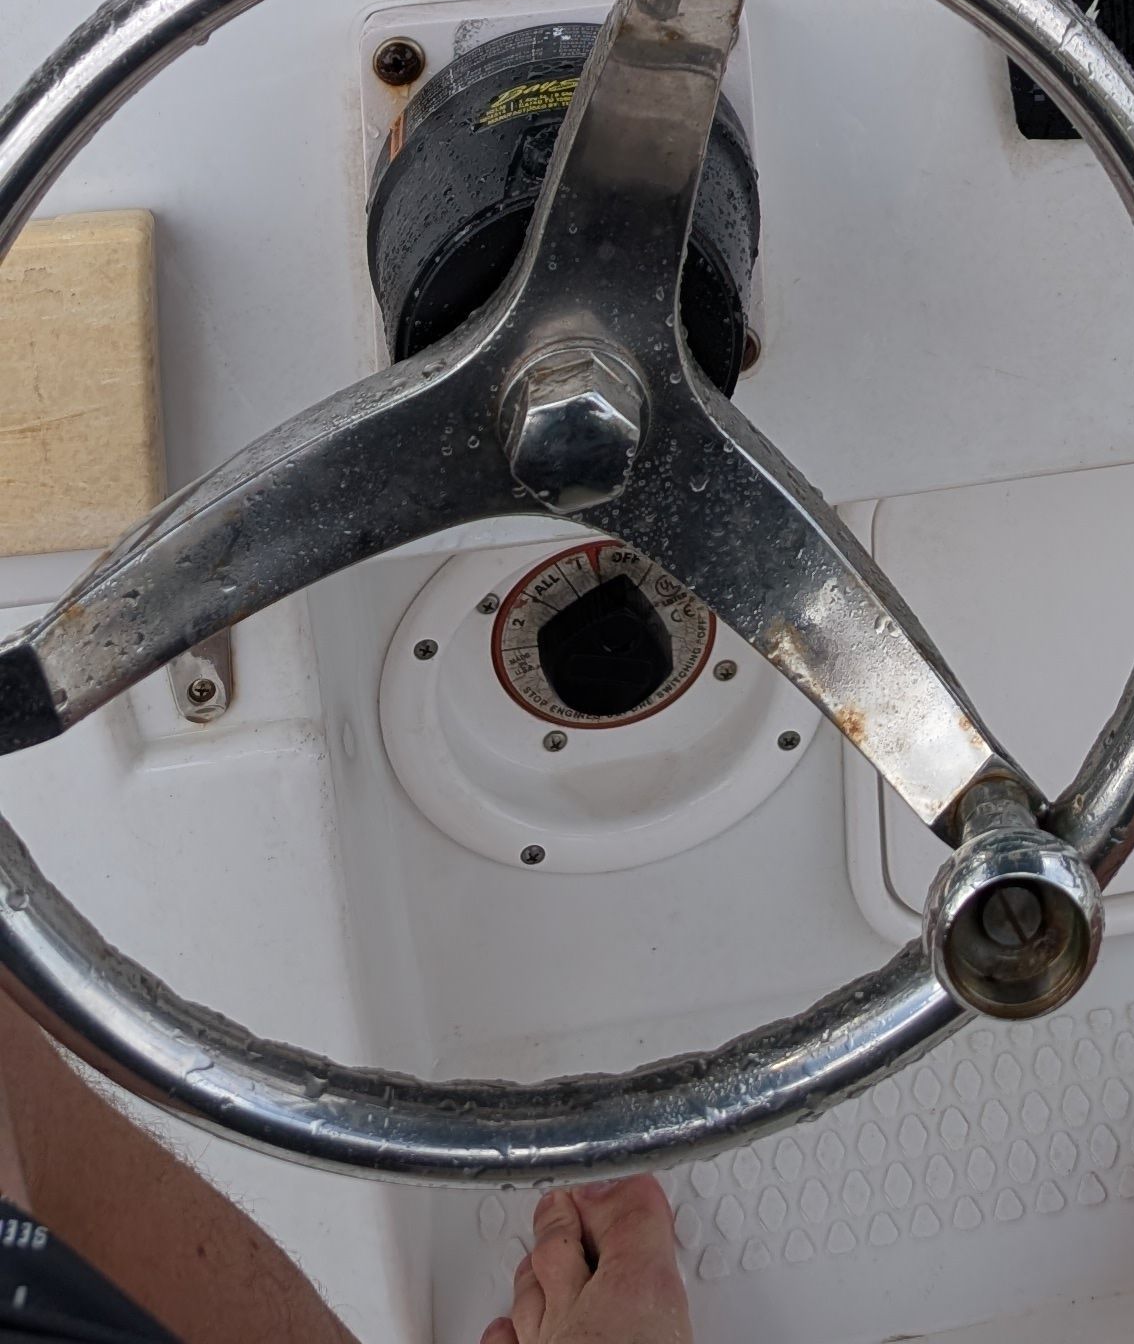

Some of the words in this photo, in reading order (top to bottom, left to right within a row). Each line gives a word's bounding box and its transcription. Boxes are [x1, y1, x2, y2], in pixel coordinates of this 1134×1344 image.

[534, 574, 560, 596] ALL
[512, 617, 525, 627] 2
[523, 686, 548, 707] STOP
[656, 647, 701, 700] SWITCHING
